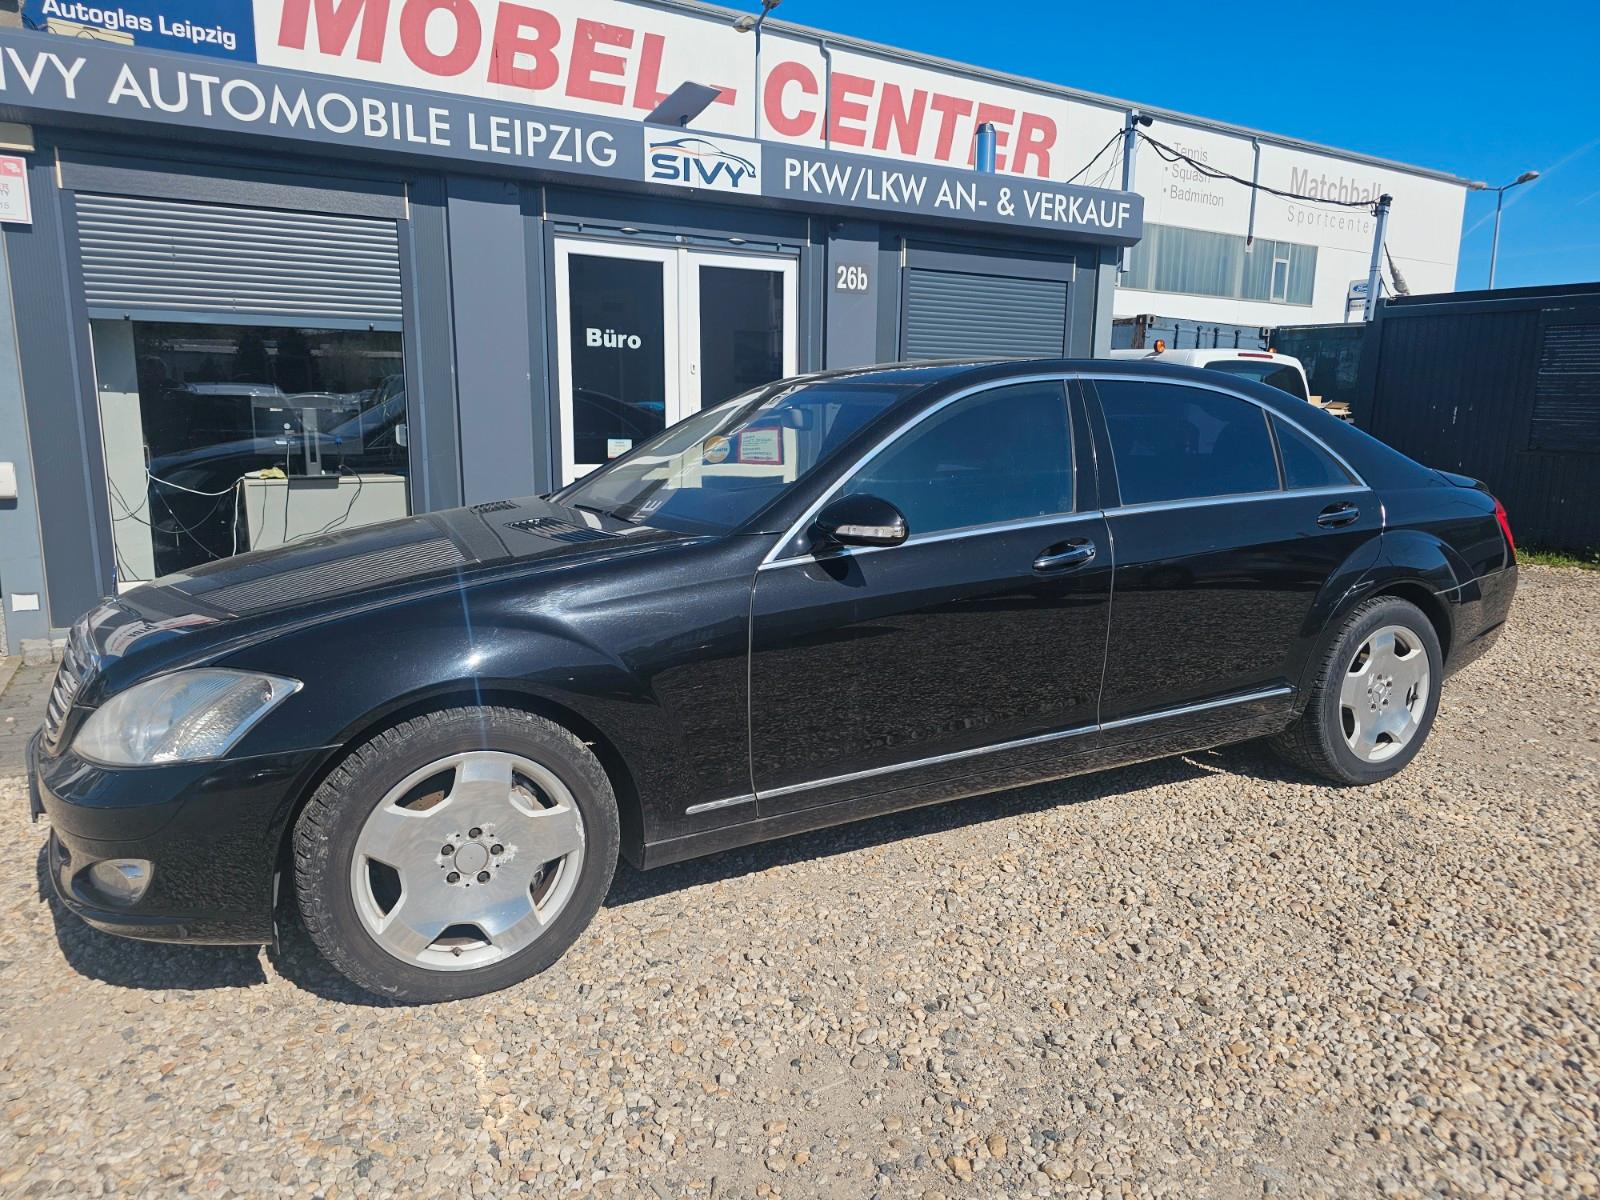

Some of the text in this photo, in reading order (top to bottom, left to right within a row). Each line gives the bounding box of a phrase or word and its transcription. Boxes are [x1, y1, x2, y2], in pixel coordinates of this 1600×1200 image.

[42, 0, 237, 51] Autoglas Leipzig
[107, 63, 451, 147] AUTOMOBILE
[468, 112, 617, 167] LEIPZIG
[763, 61, 1058, 179] CENTER
[1174, 142, 1208, 162] Tennis
[651, 153, 745, 188] SIVY
[784, 157, 1131, 229] PKW/LKW AN- & VERKAUF
[1170, 184, 1224, 208] Badminton
[836, 265, 869, 291] 26b
[585, 327, 642, 349] Büro
